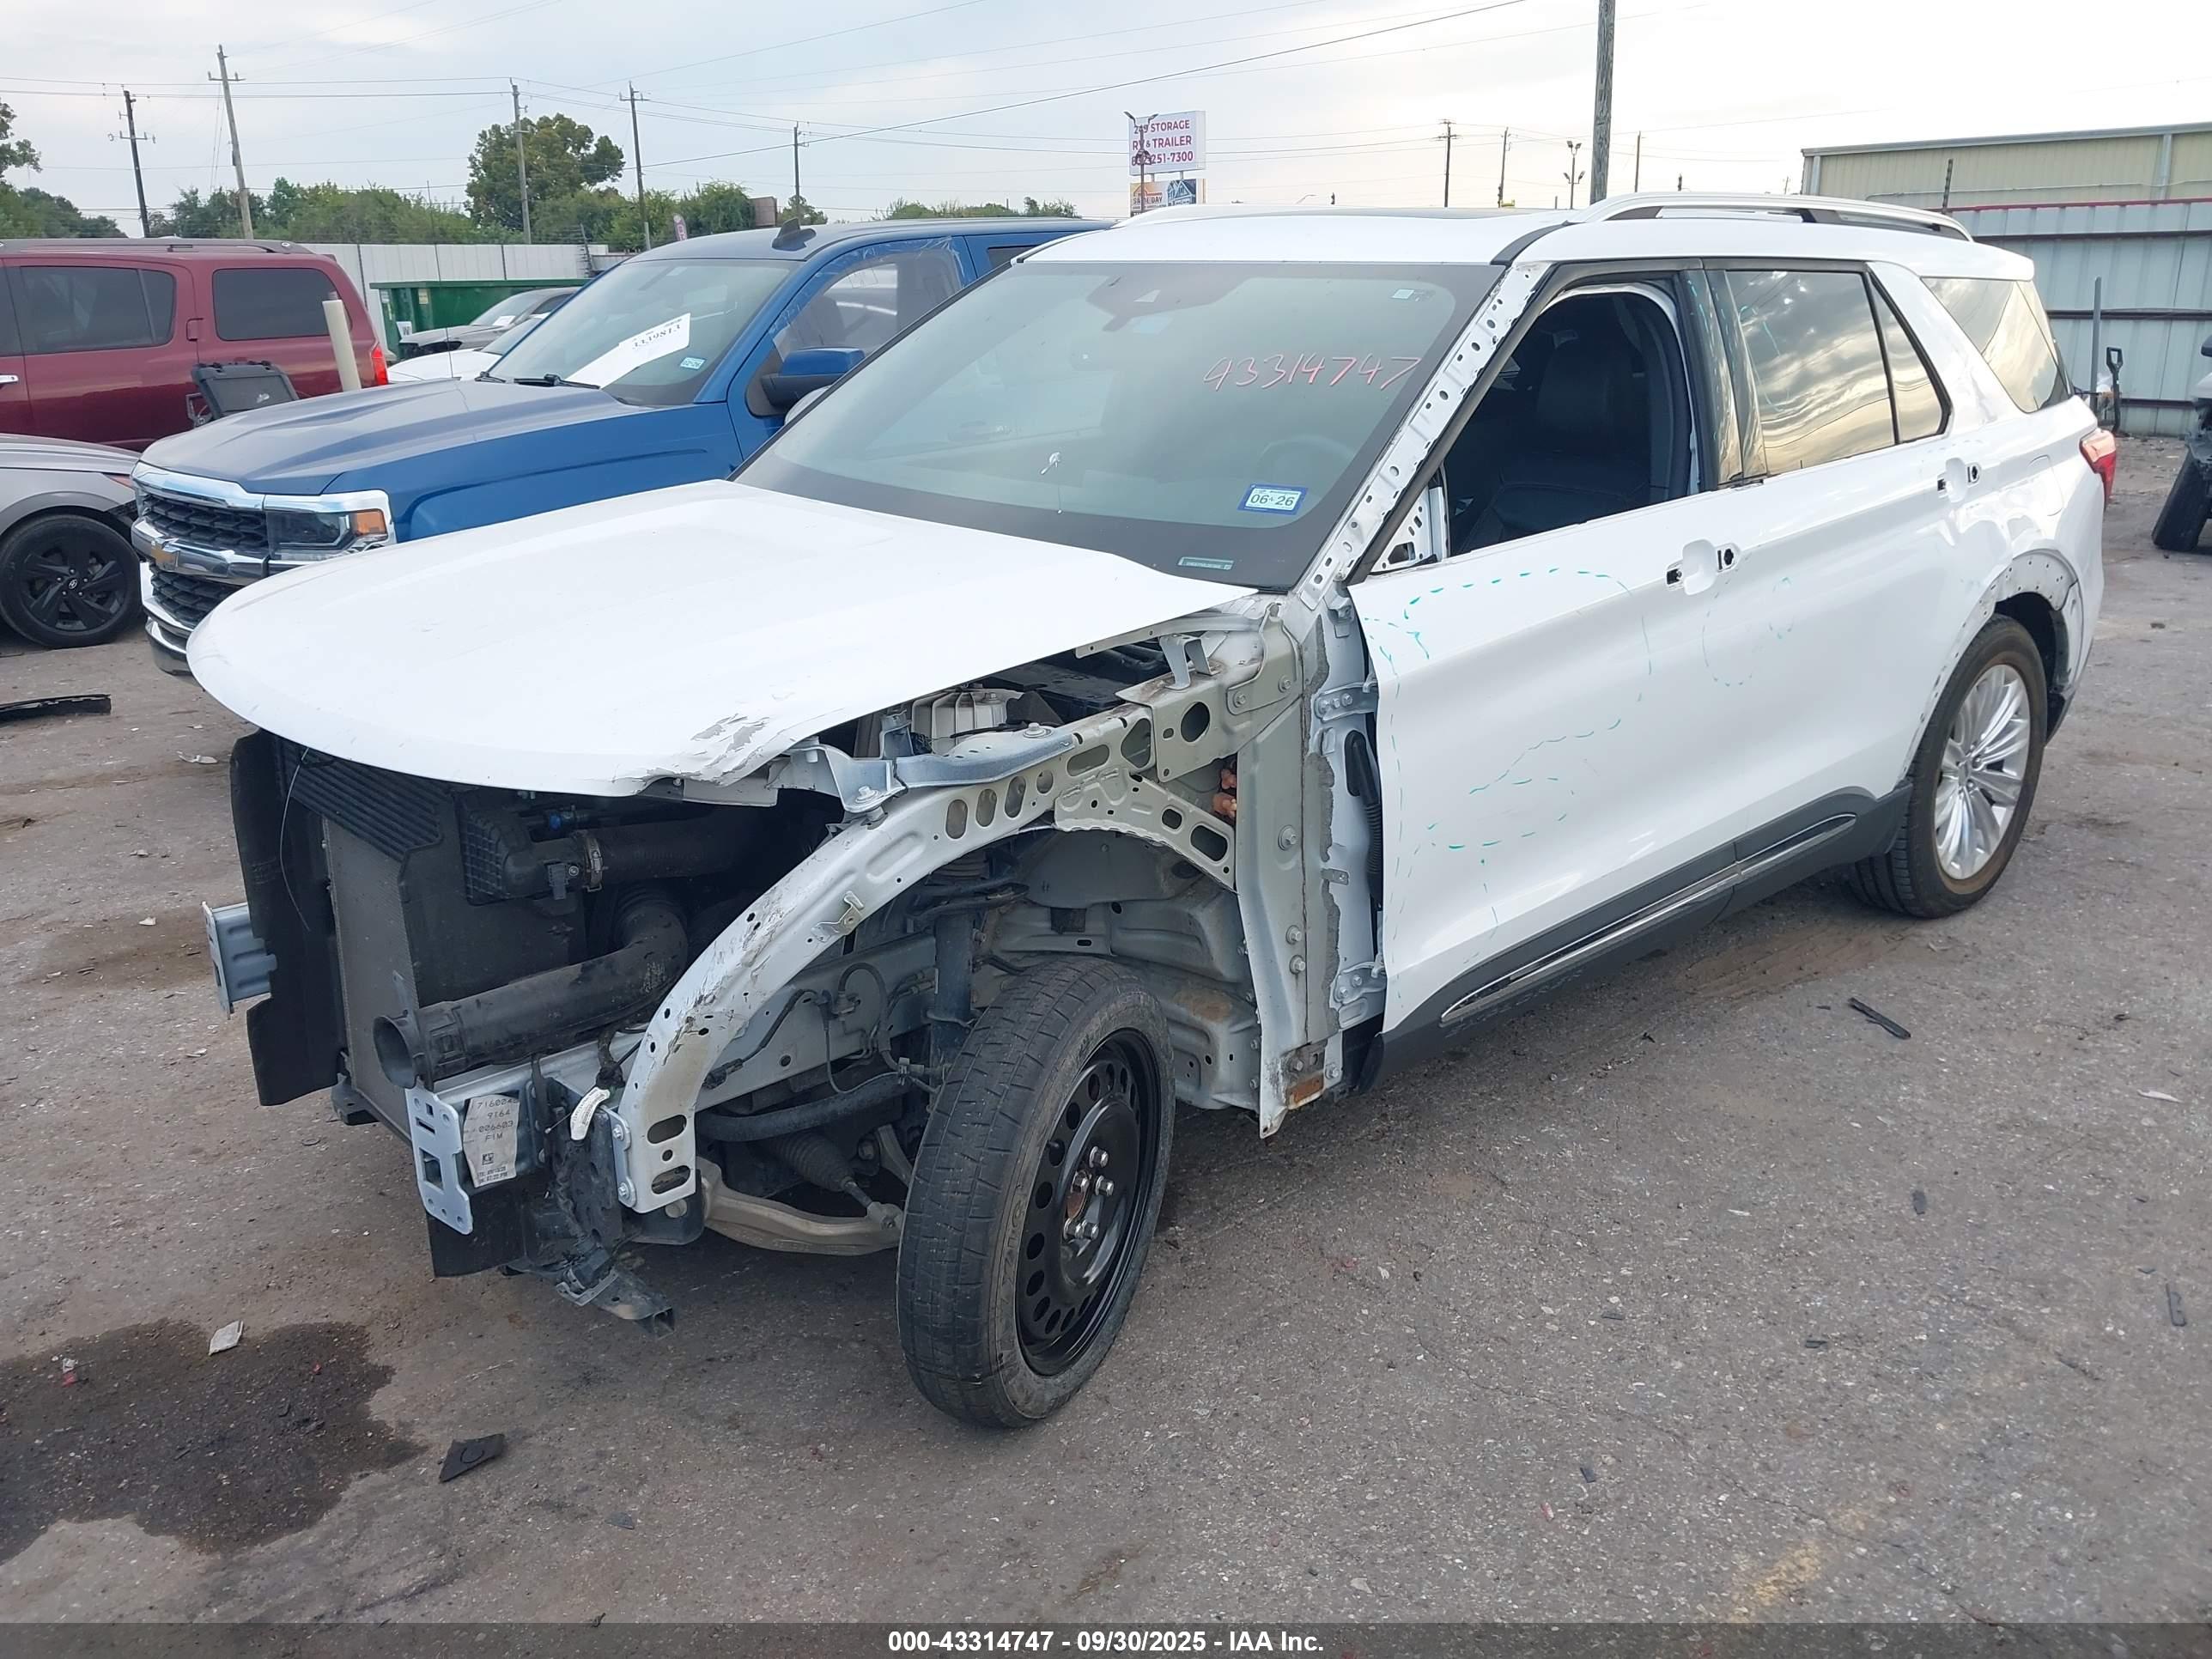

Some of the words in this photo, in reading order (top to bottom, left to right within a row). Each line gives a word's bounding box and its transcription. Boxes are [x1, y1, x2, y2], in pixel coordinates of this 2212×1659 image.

[1151, 119, 1190, 132] STORAGE
[1152, 135, 1192, 148] TRAILER
[1202, 352, 1421, 392] 43314747
[1250, 494, 1270, 504] 06
[1275, 495, 1295, 507] 26
